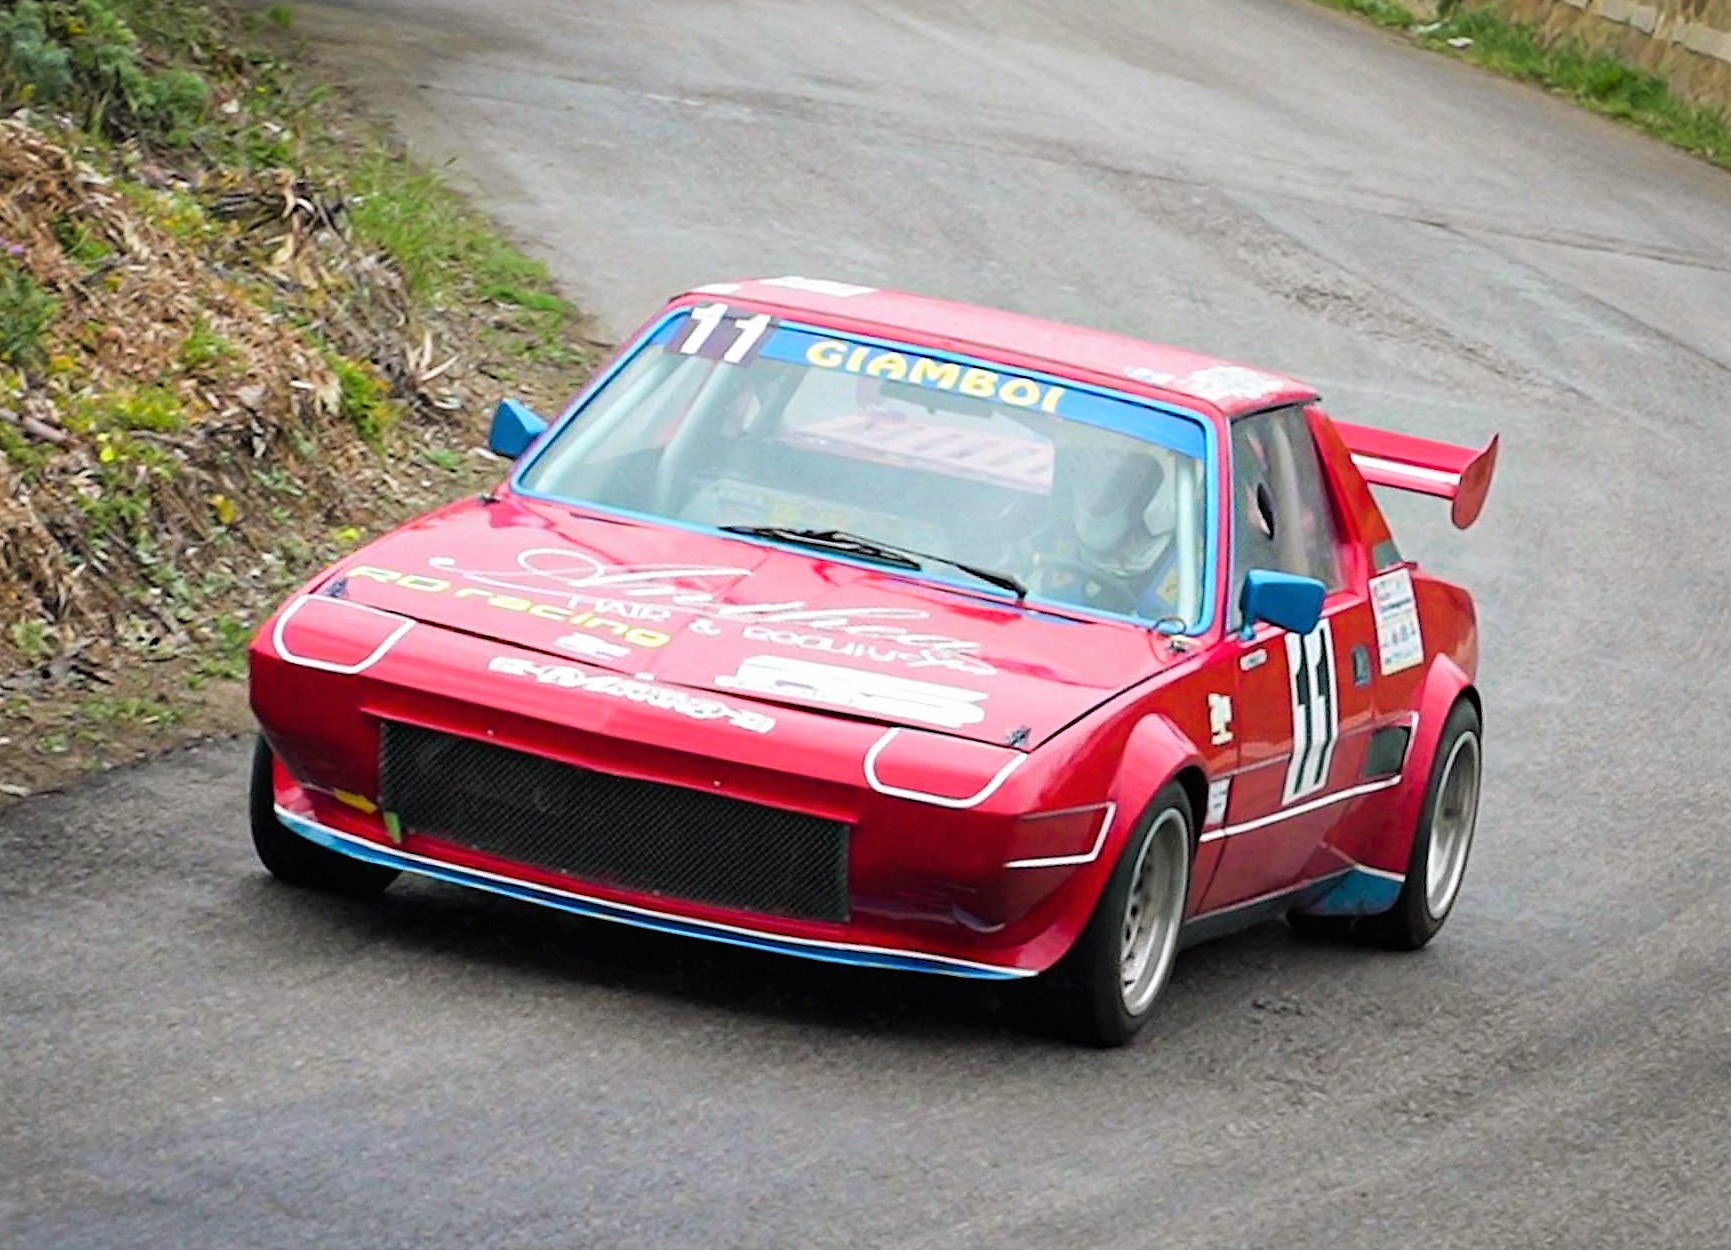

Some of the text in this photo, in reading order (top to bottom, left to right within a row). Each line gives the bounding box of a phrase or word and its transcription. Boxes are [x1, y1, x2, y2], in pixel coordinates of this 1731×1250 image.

[680, 303, 770, 363] 11
[806, 340, 1065, 413] GIAMBOI
[1291, 627, 1332, 796] 11
